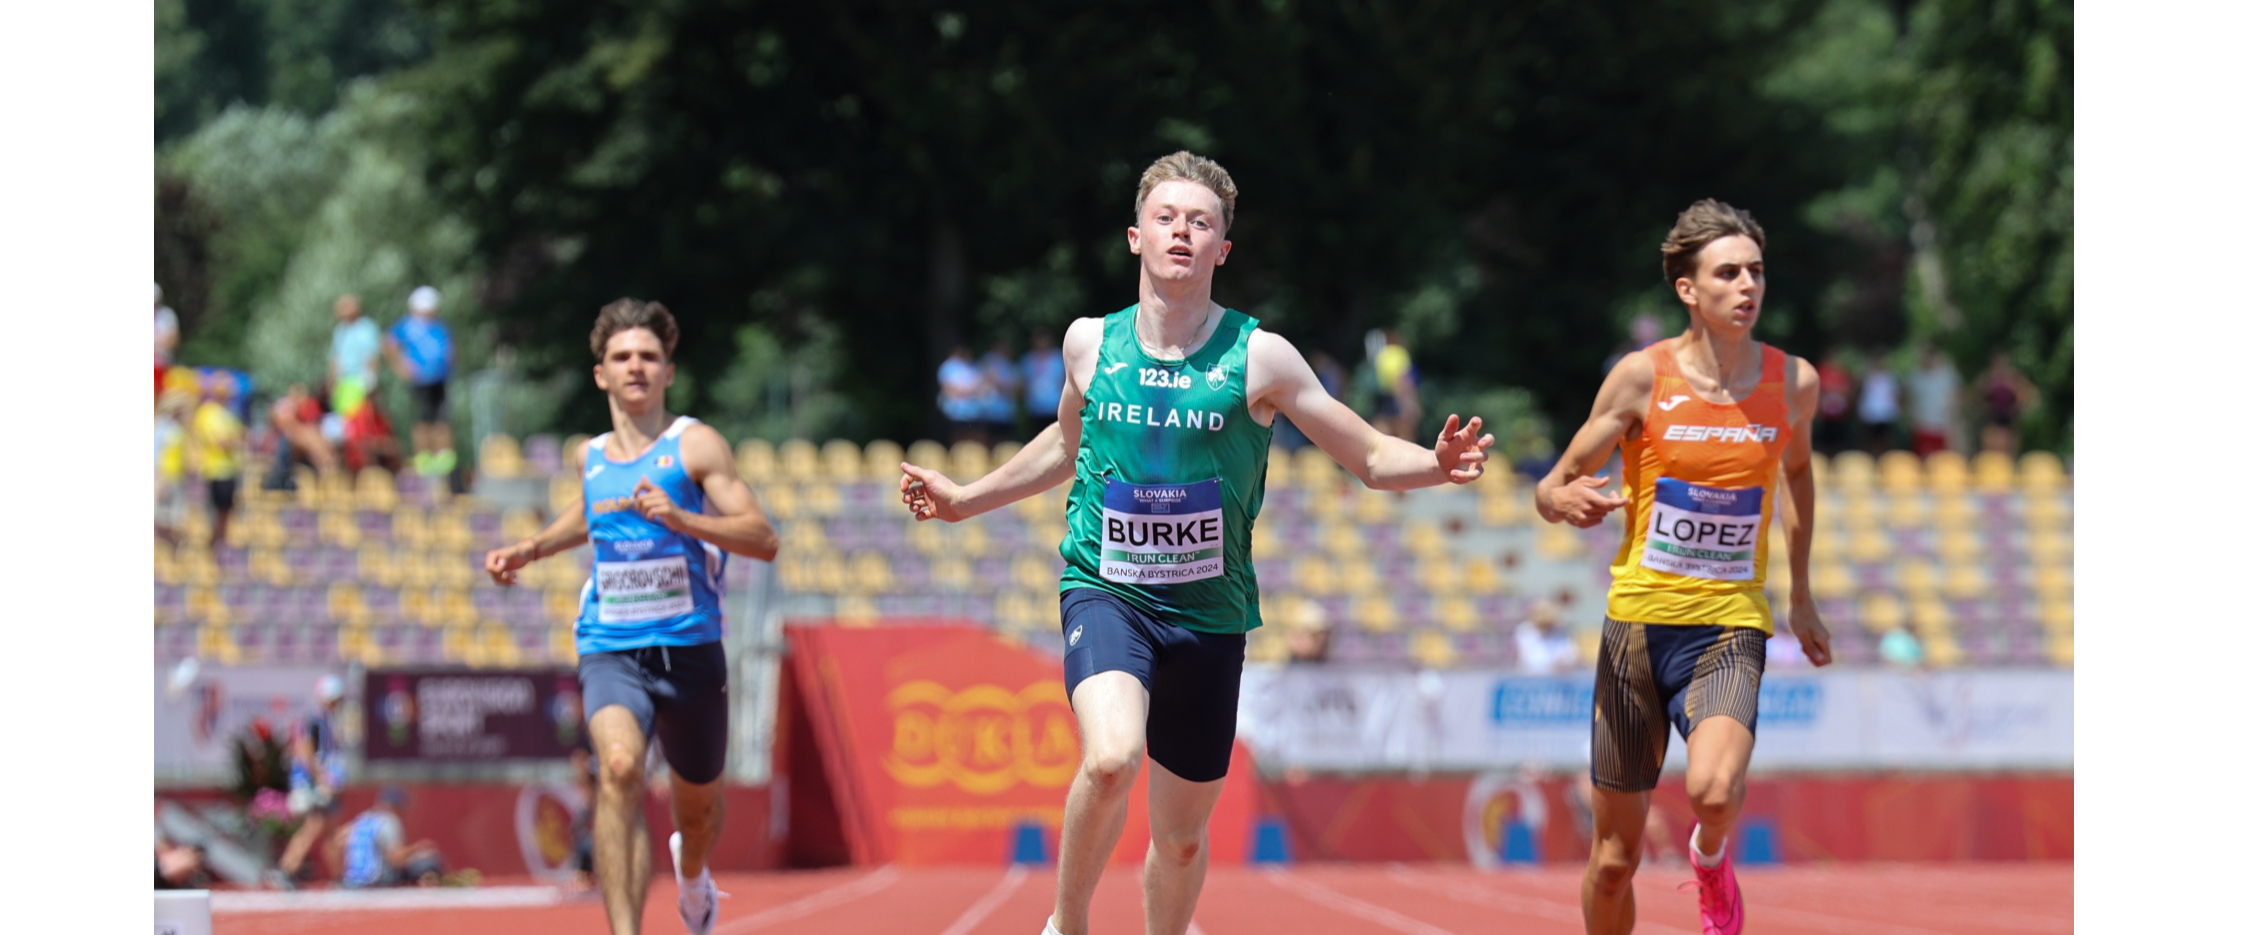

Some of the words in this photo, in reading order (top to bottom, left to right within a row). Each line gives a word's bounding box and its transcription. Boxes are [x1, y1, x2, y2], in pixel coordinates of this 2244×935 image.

[1138, 368, 1192, 389] 123.ie
[1098, 401, 1225, 431] IRELAND
[1662, 424, 1779, 443] ESPAÑA
[1133, 489, 1187, 498] SLOVAKIA
[1108, 517, 1219, 546] BURKE
[1654, 511, 1755, 547] LOPEZ
[1131, 554, 1156, 564] RUN
[1148, 567, 1195, 578] BYSTRICA
[1196, 563, 1218, 575] 2024
